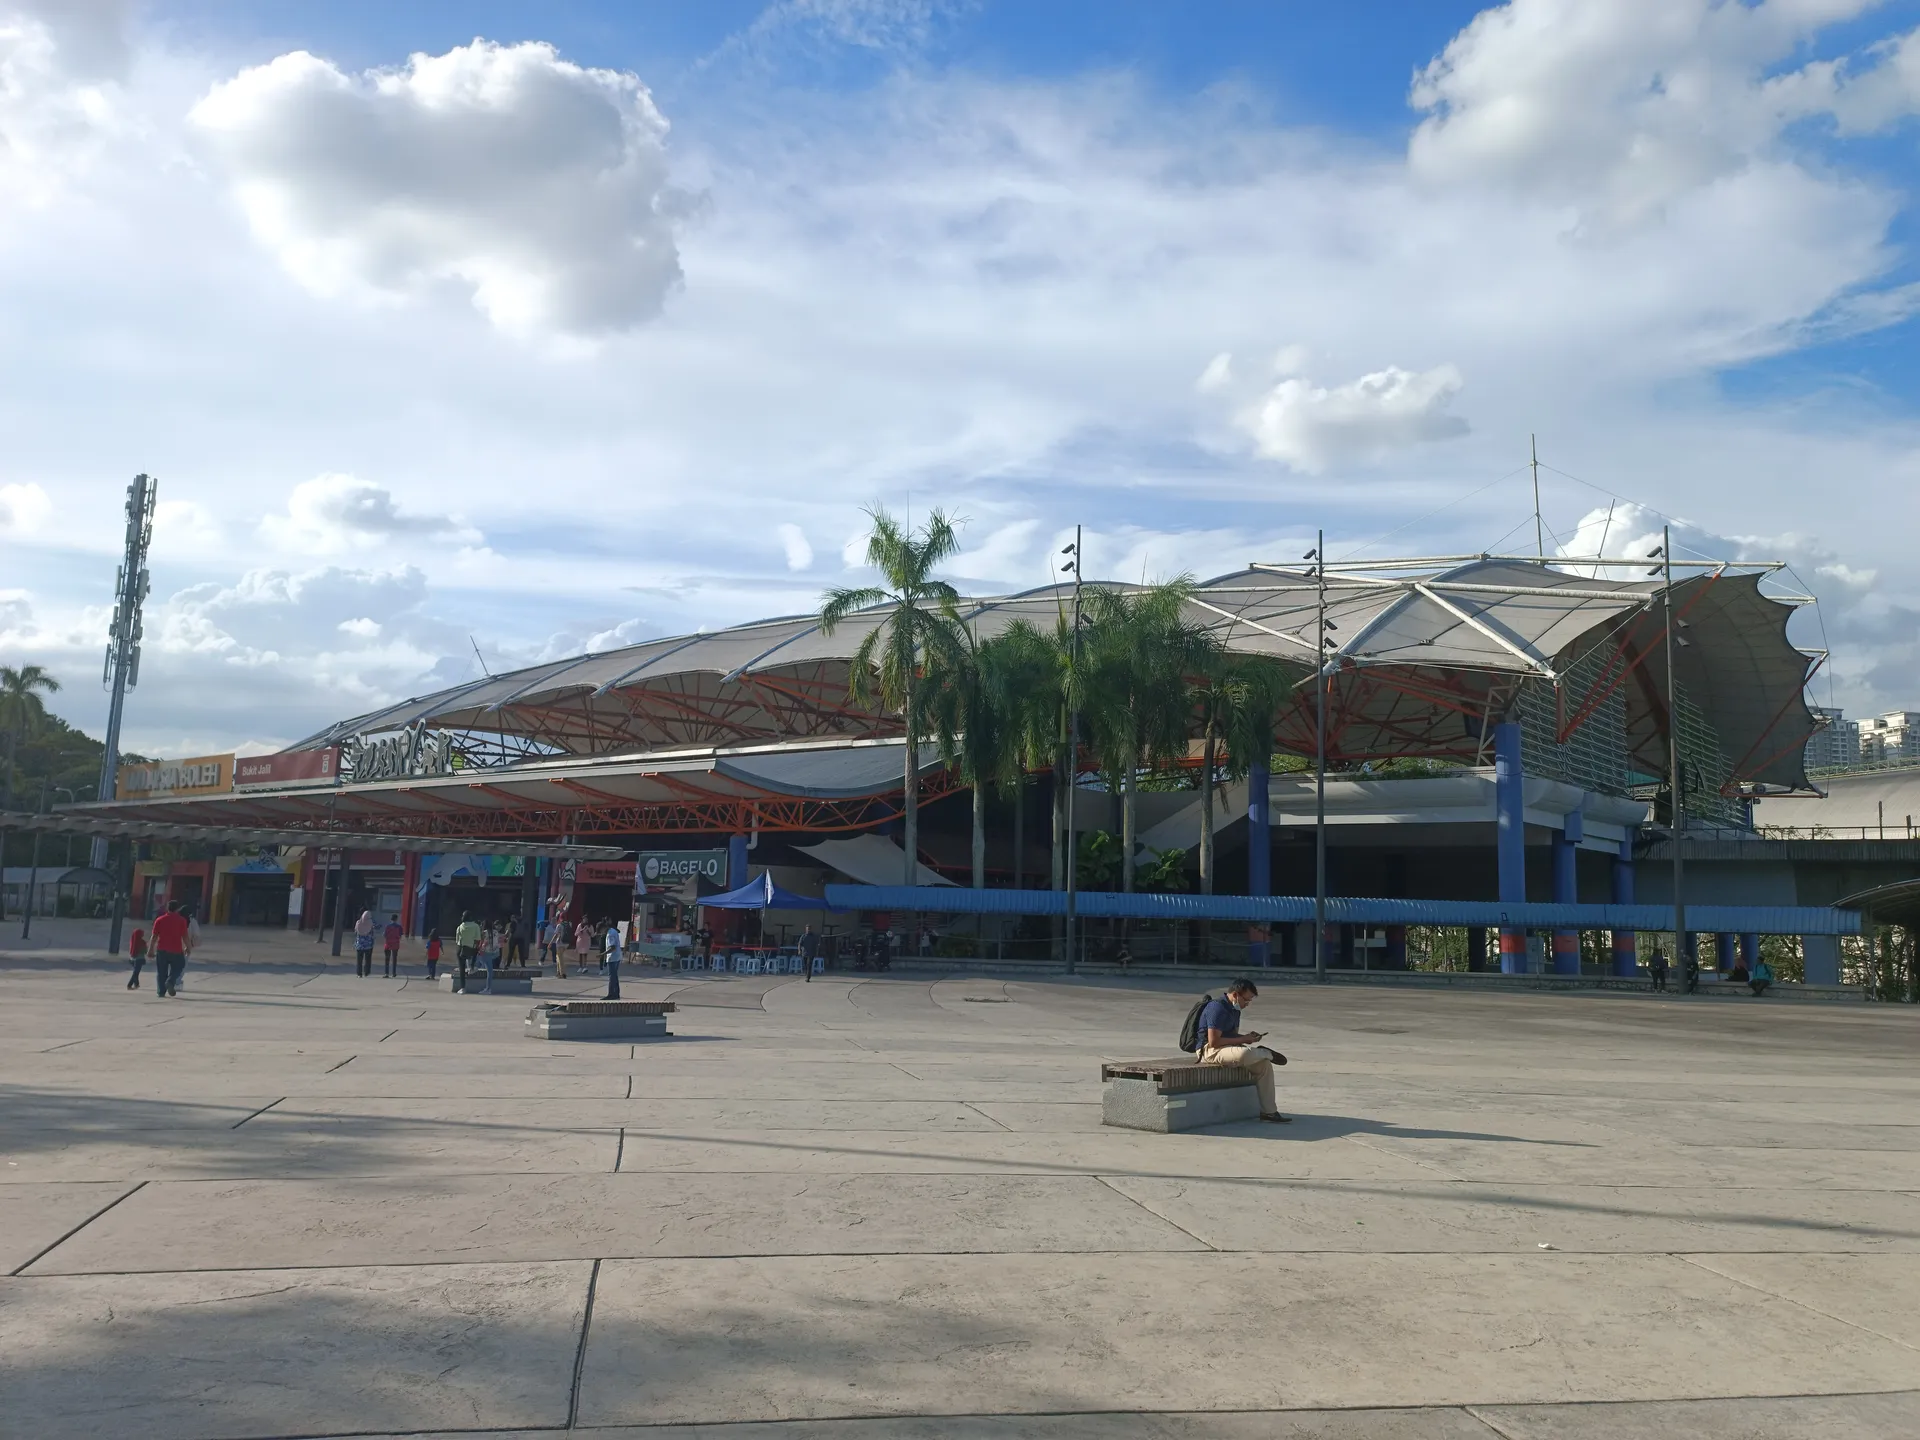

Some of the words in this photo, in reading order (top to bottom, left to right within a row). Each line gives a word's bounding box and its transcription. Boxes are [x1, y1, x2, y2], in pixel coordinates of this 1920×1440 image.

[179, 763, 219, 788] BOLEH
[242, 765, 257, 777] Bukit
[258, 763, 271, 775] Jalil
[659, 858, 718, 877] BAGELO
